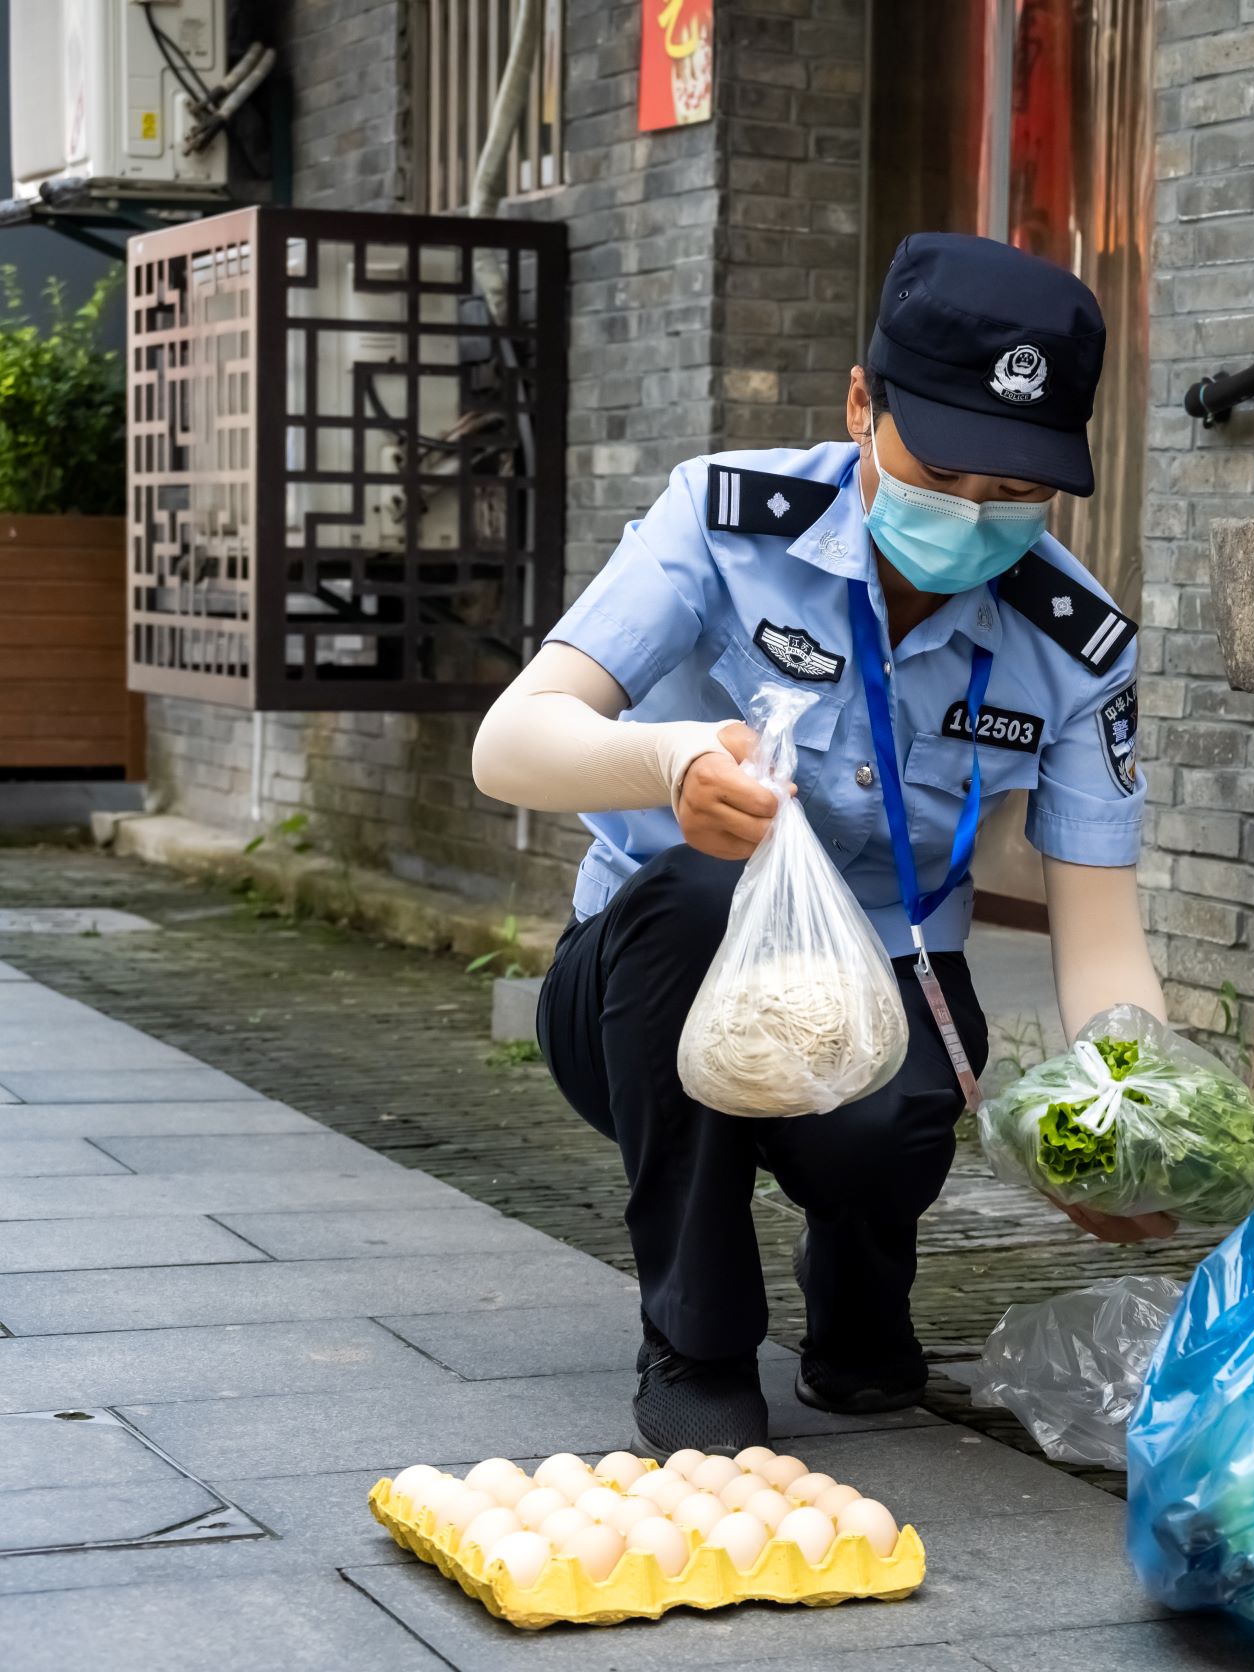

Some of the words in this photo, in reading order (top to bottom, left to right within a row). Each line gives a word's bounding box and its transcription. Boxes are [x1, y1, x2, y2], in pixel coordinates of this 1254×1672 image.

[1003, 389, 1030, 401] POLICE
[791, 638, 810, 653] 江苏
[786, 646, 809, 661] POLICE
[949, 708, 1035, 744] 102503
